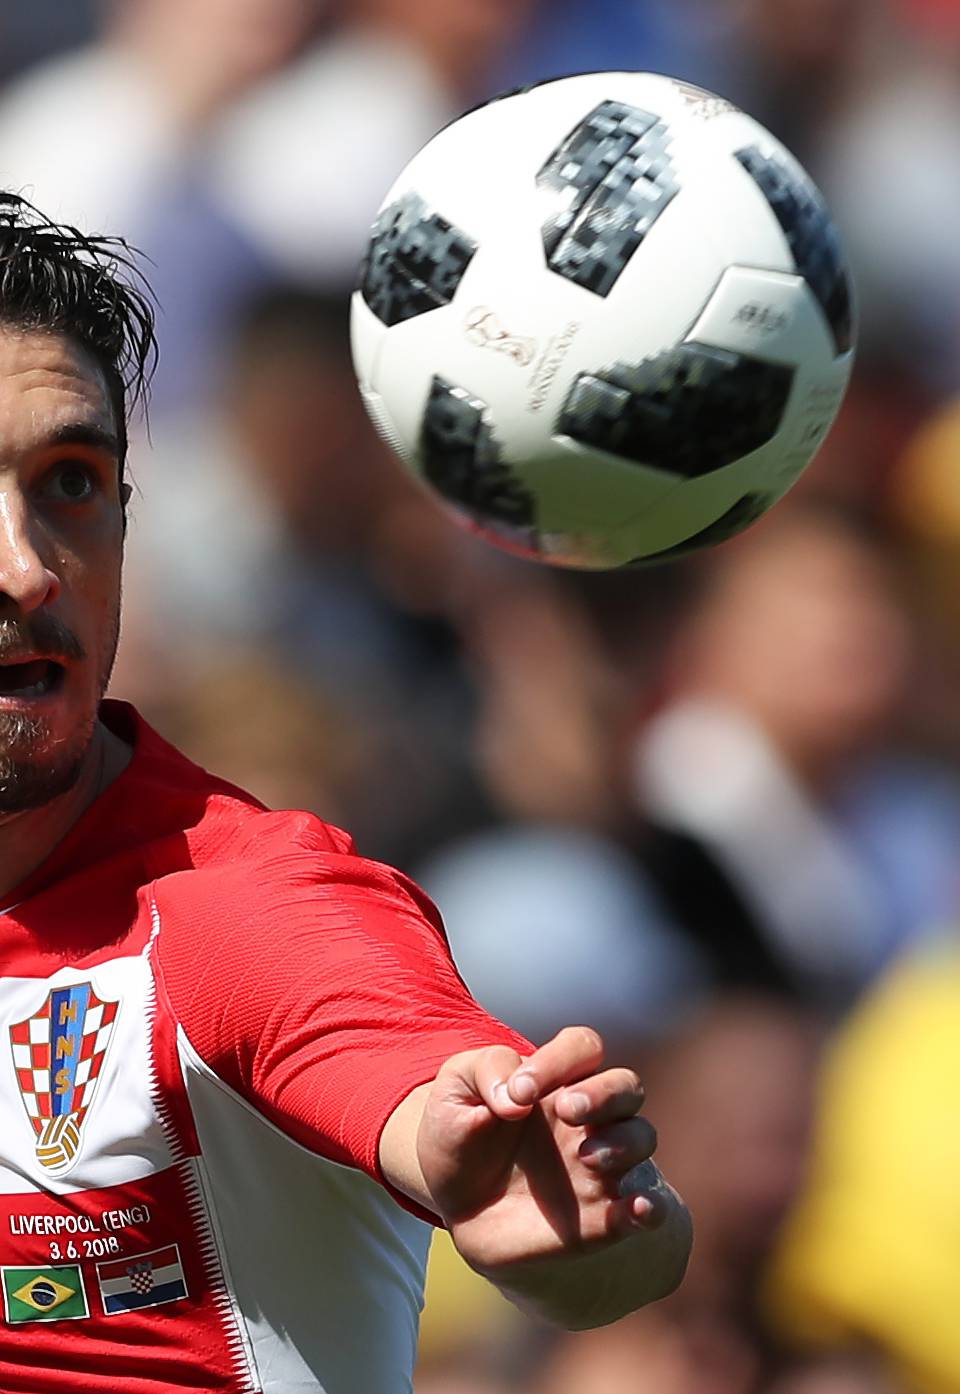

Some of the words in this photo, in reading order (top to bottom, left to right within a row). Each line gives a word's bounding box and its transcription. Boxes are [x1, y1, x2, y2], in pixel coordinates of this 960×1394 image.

[55, 1001, 78, 1095] HNS
[10, 1214, 101, 1235] LIVERPOOL
[102, 1204, 150, 1232] (ENG)
